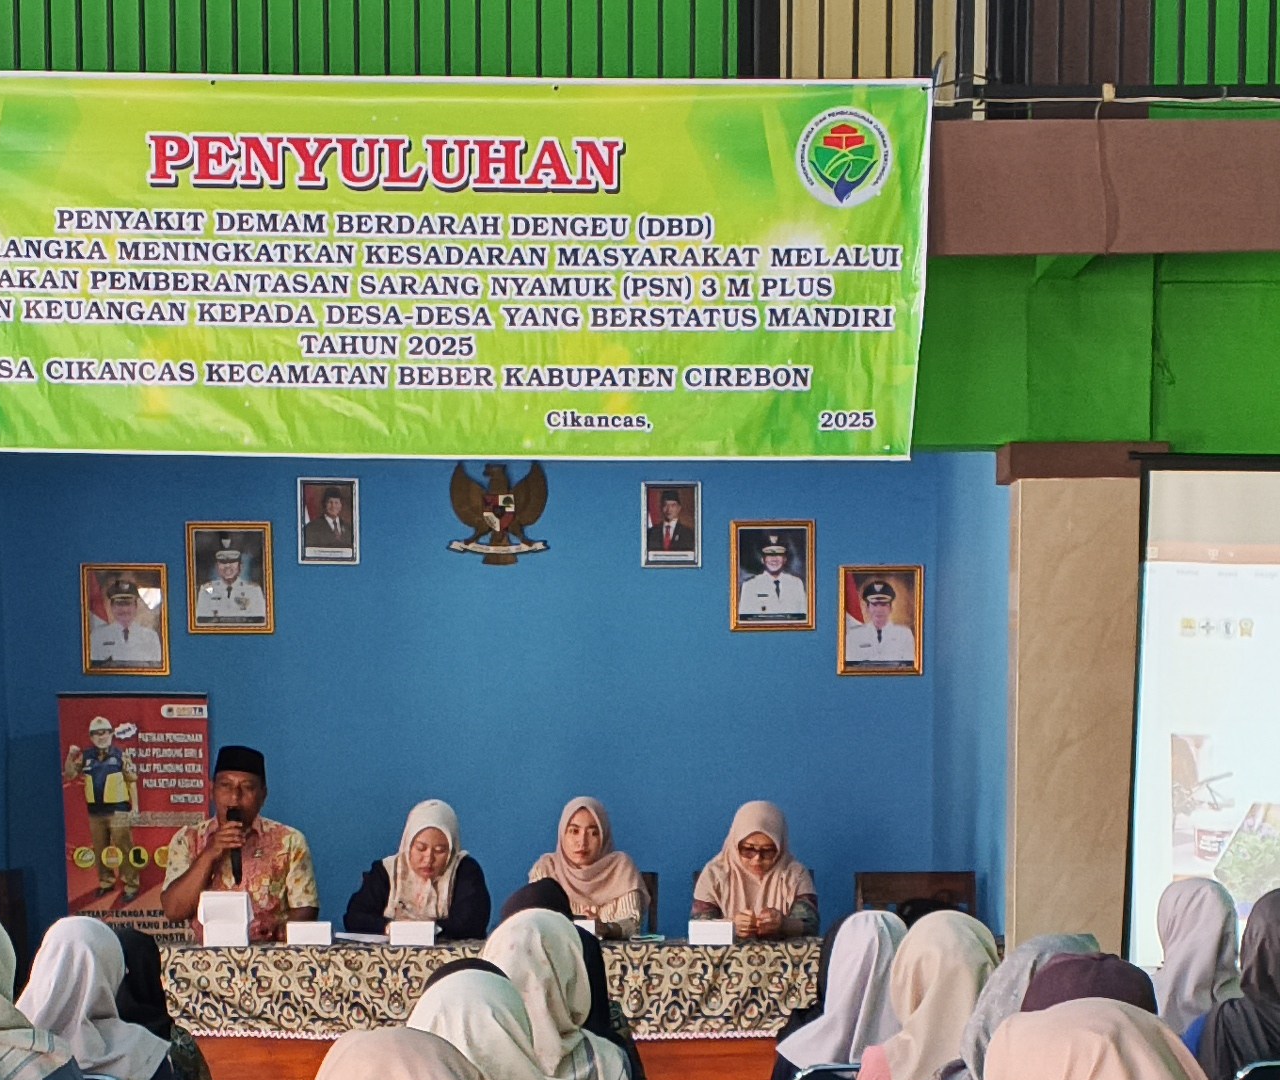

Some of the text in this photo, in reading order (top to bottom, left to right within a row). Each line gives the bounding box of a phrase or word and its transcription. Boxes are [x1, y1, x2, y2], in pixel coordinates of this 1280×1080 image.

[148, 133, 624, 191] PENYULUHAN
[57, 209, 712, 240] PENYAKIT DEMAM BERDARAH DENGEU (DBD)
[118, 241, 354, 264] MENINGKATKAN
[365, 245, 546, 266] KESADARAN
[557, 247, 759, 268] MASYARAKAT
[771, 247, 902, 268] MELALUI
[91, 270, 349, 294] PEMBERANTASAN
[360, 275, 479, 296] SARANG
[491, 277, 612, 297] NYAMUK
[623, 276, 693, 300] (PSN)
[701, 278, 717, 298] 3
[727, 278, 750, 297] M
[761, 278, 833, 298] PLUS
[24, 300, 186, 321] KEUANGAN
[198, 303, 315, 324] KEPADA
[326, 306, 492, 326] DESA-DESA
[504, 307, 580, 327] YANG
[591, 308, 758, 328] BERSTATUS
[767, 308, 894, 328] MANDIRI
[301, 335, 473, 356] TAHUN 2025
[46, 360, 195, 382] CIKANCAS
[206, 363, 387, 384] KECAMATAN
[398, 366, 494, 386] BEBER
[504, 367, 675, 387] KABUPATEN
[685, 367, 811, 388] CIREBON
[546, 411, 875, 430] Cikancas, 2025
